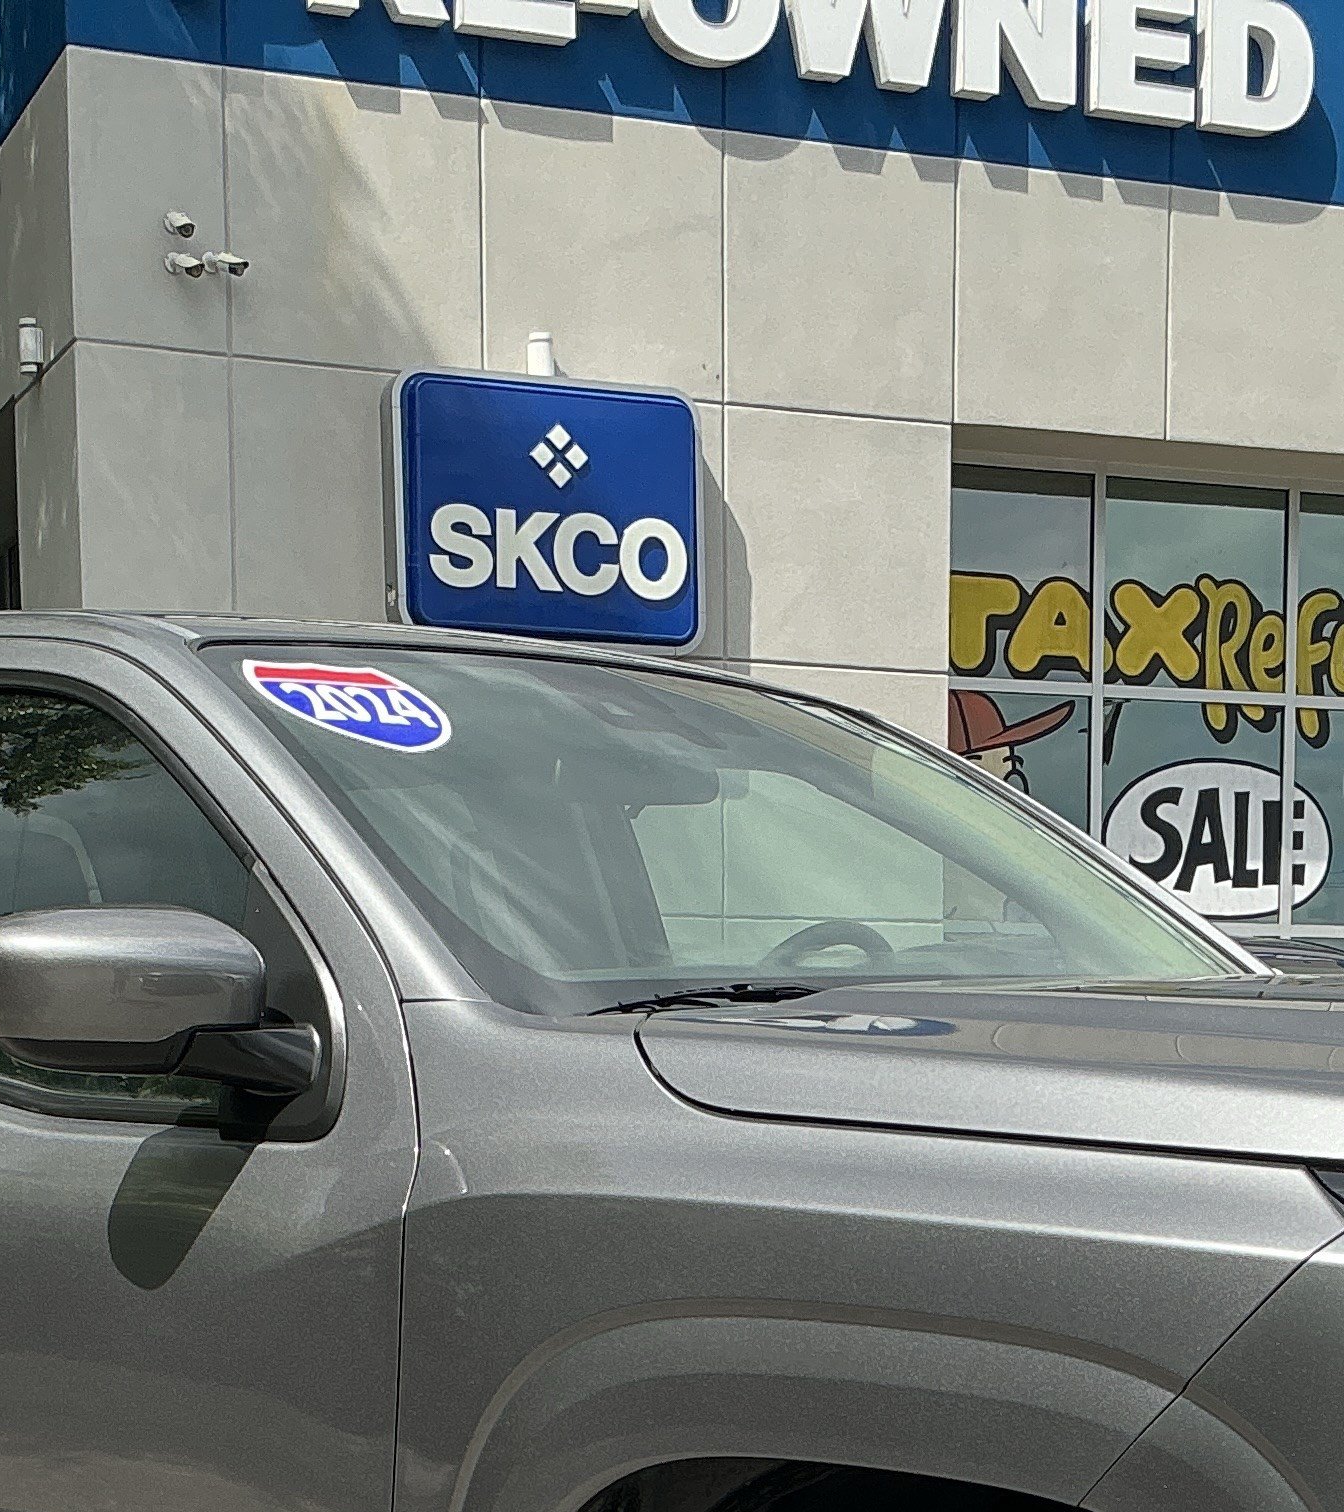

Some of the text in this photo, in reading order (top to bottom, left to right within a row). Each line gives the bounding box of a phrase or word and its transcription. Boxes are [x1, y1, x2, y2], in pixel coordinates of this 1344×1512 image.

[429, 503, 688, 601] SKCO
[950, 572, 1201, 684] TAX
[282, 683, 440, 729] 2024
[1128, 786, 1306, 893] SALE
